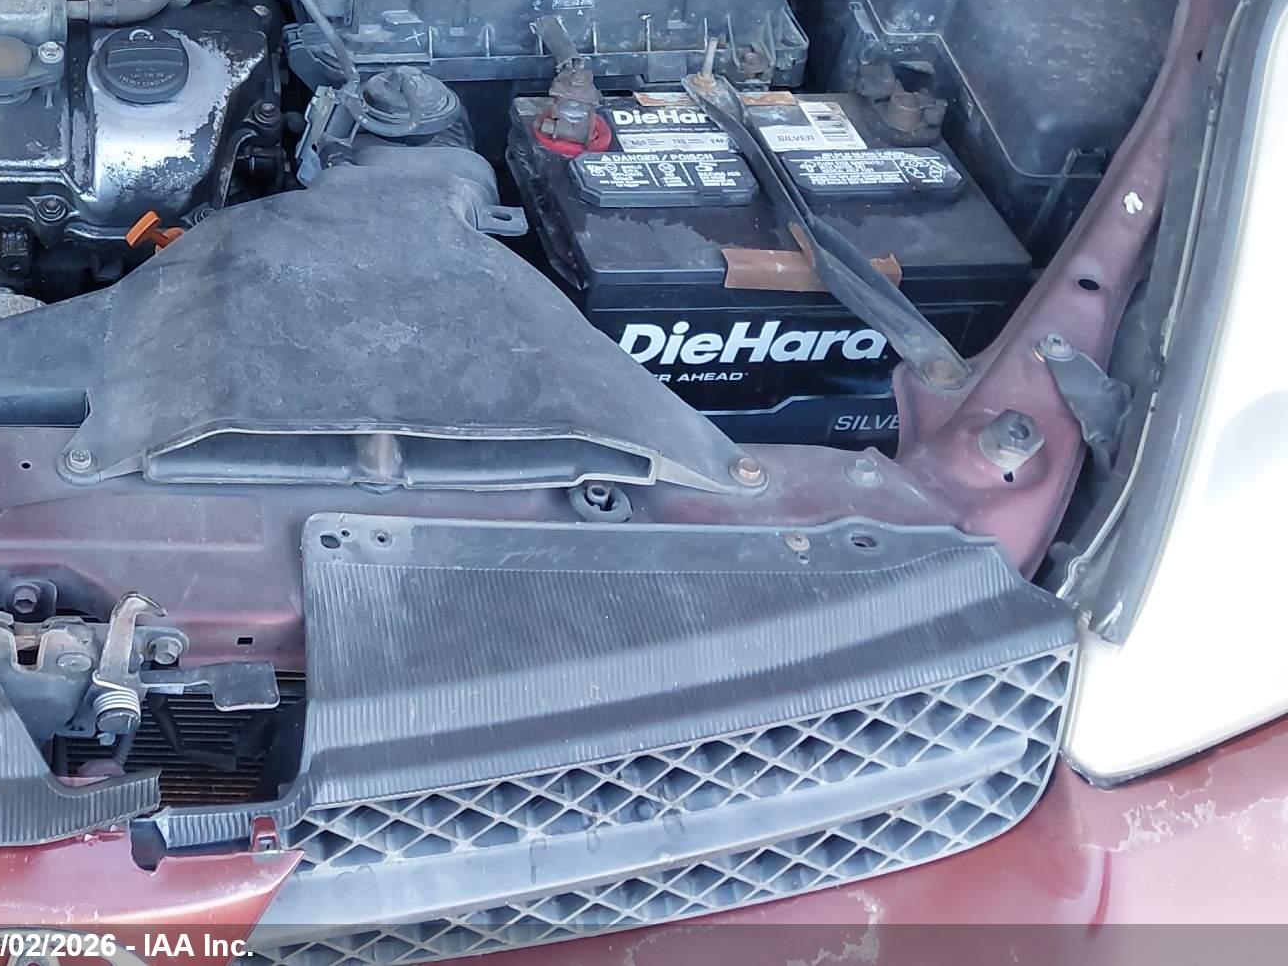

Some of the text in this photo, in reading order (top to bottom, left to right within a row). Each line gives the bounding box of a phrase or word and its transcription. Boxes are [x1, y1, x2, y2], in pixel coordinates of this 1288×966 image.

[612, 109, 710, 125] DieHar
[777, 134, 815, 143] SILVER
[612, 154, 659, 162] DANGER
[671, 153, 714, 161] POISON
[677, 372, 743, 382] AHEAD
[834, 414, 900, 431] SILVE
